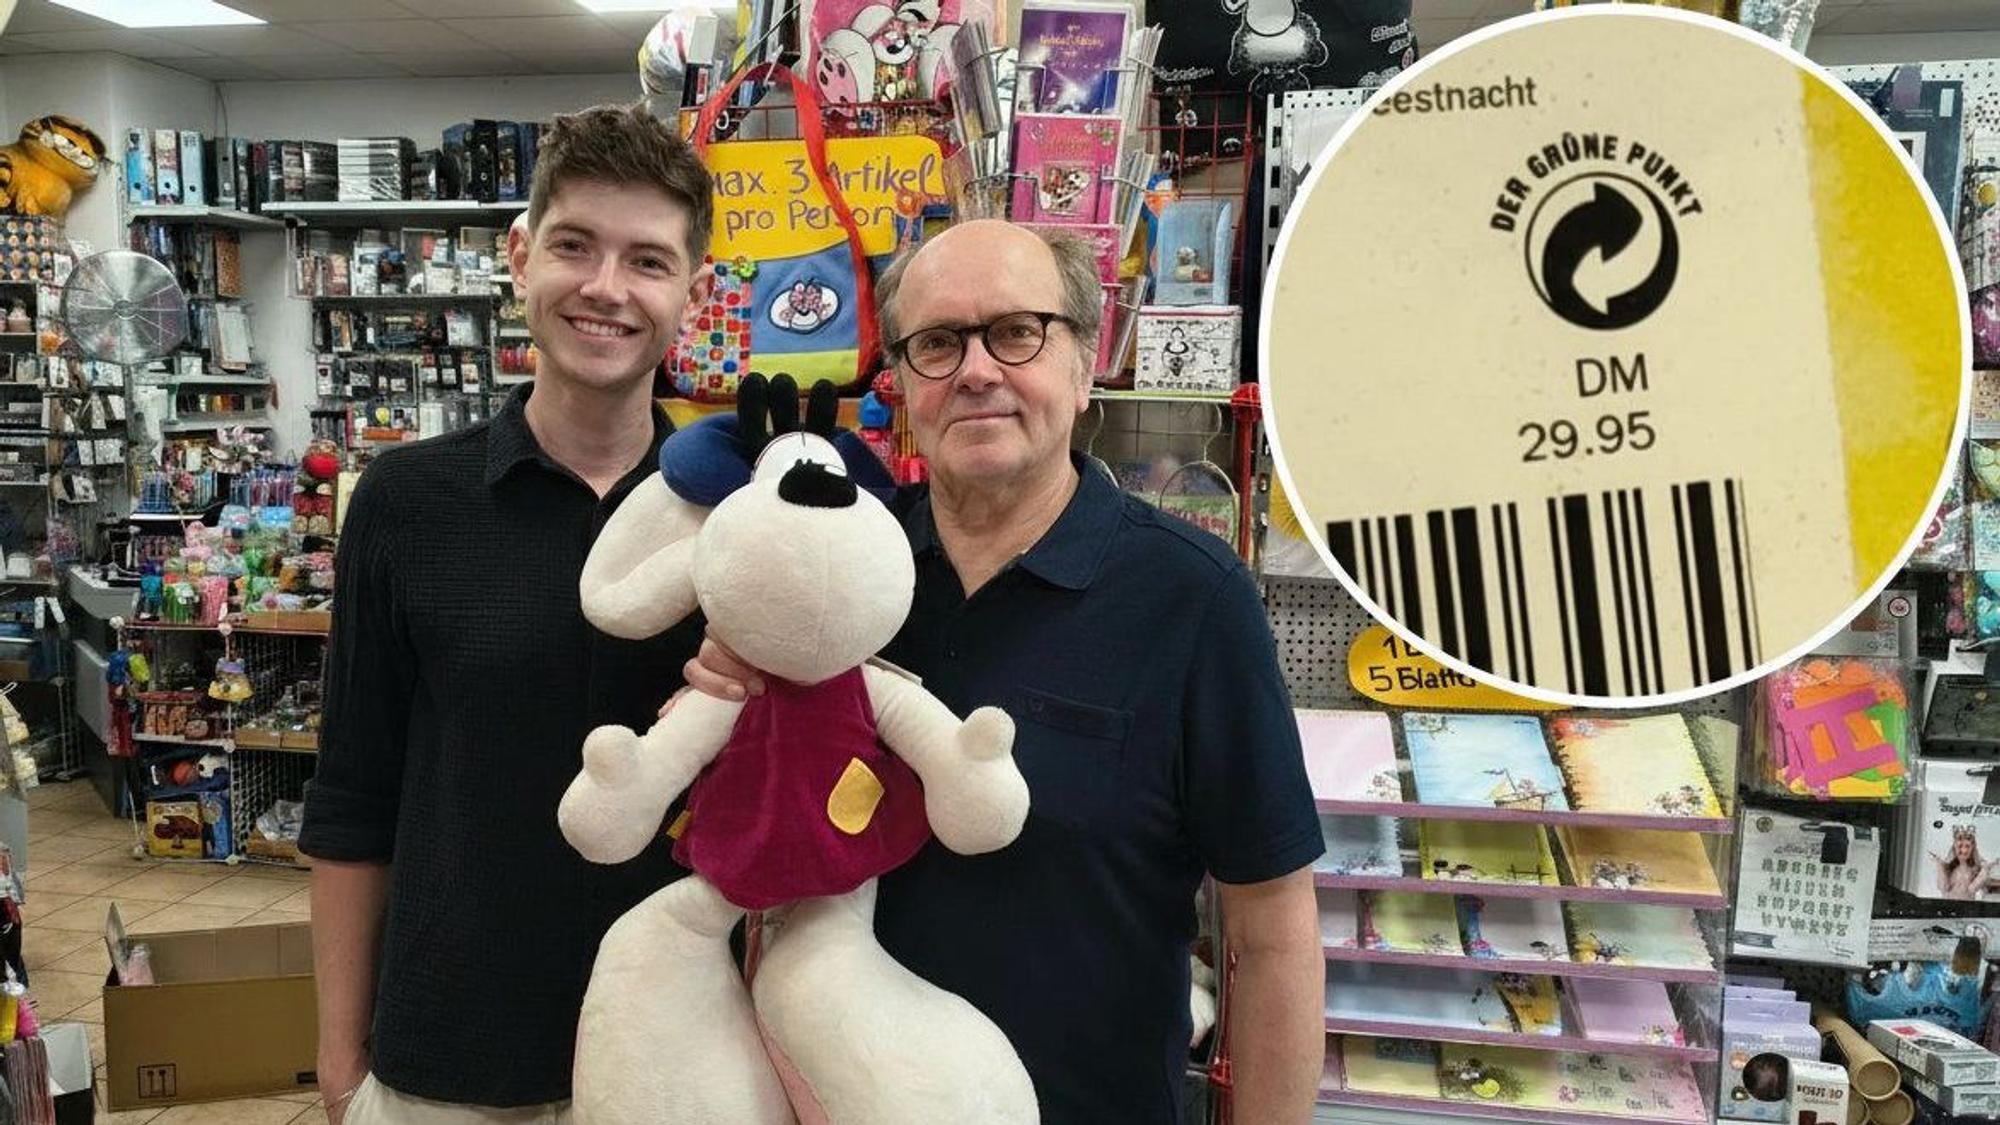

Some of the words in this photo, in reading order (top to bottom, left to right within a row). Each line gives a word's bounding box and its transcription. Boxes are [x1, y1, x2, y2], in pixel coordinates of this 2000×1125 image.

[785, 159, 810, 194] 3
[1490, 176, 1532, 232] DER
[1527, 132, 1618, 178] GRÜNE
[1626, 142, 1703, 217] PUNKT
[726, 208, 774, 241] pro
[789, 199, 894, 230] Peron
[1576, 353, 1648, 397] DM
[1518, 411, 1656, 462] 29.95
[1368, 666, 1393, 692] 5
